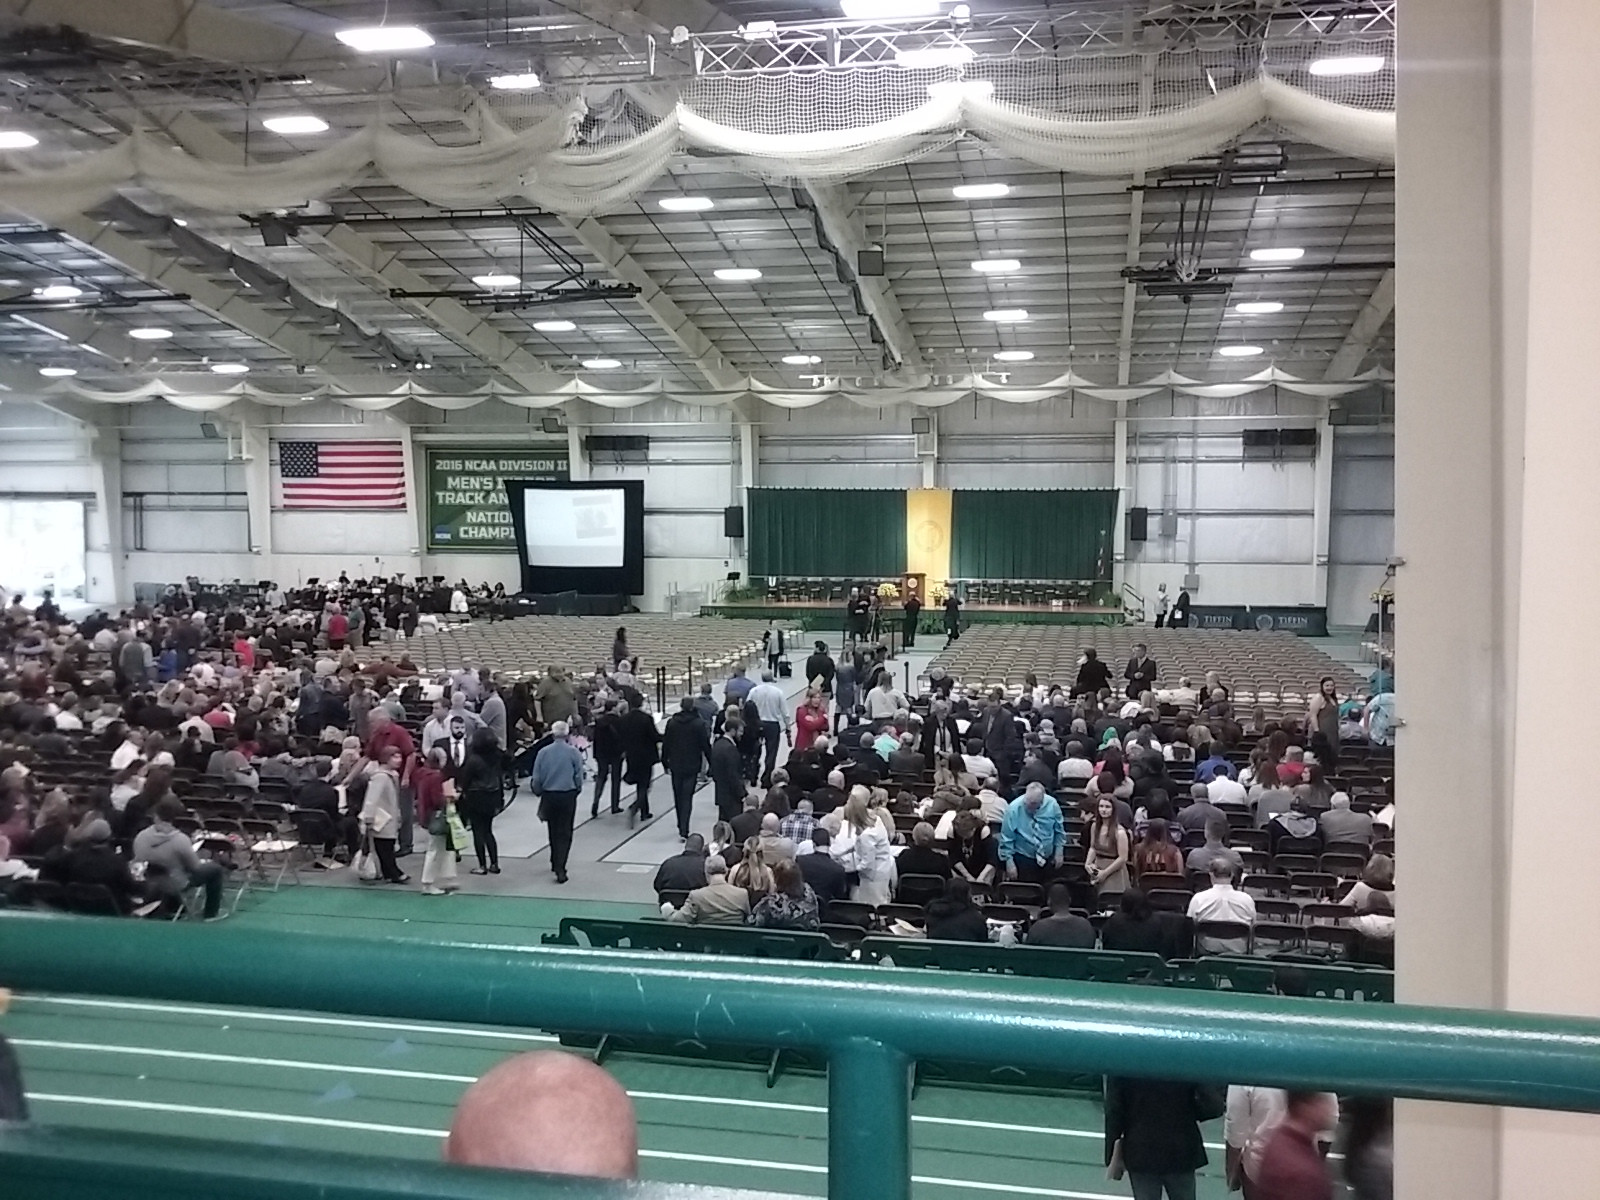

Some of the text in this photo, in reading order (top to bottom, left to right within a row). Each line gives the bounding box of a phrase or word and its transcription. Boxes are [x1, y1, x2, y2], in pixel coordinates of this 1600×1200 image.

[435, 460, 567, 471] 2016 NCAA DIVISION II
[447, 476, 493, 489] MEN'S
[436, 492, 484, 504] TRACK
